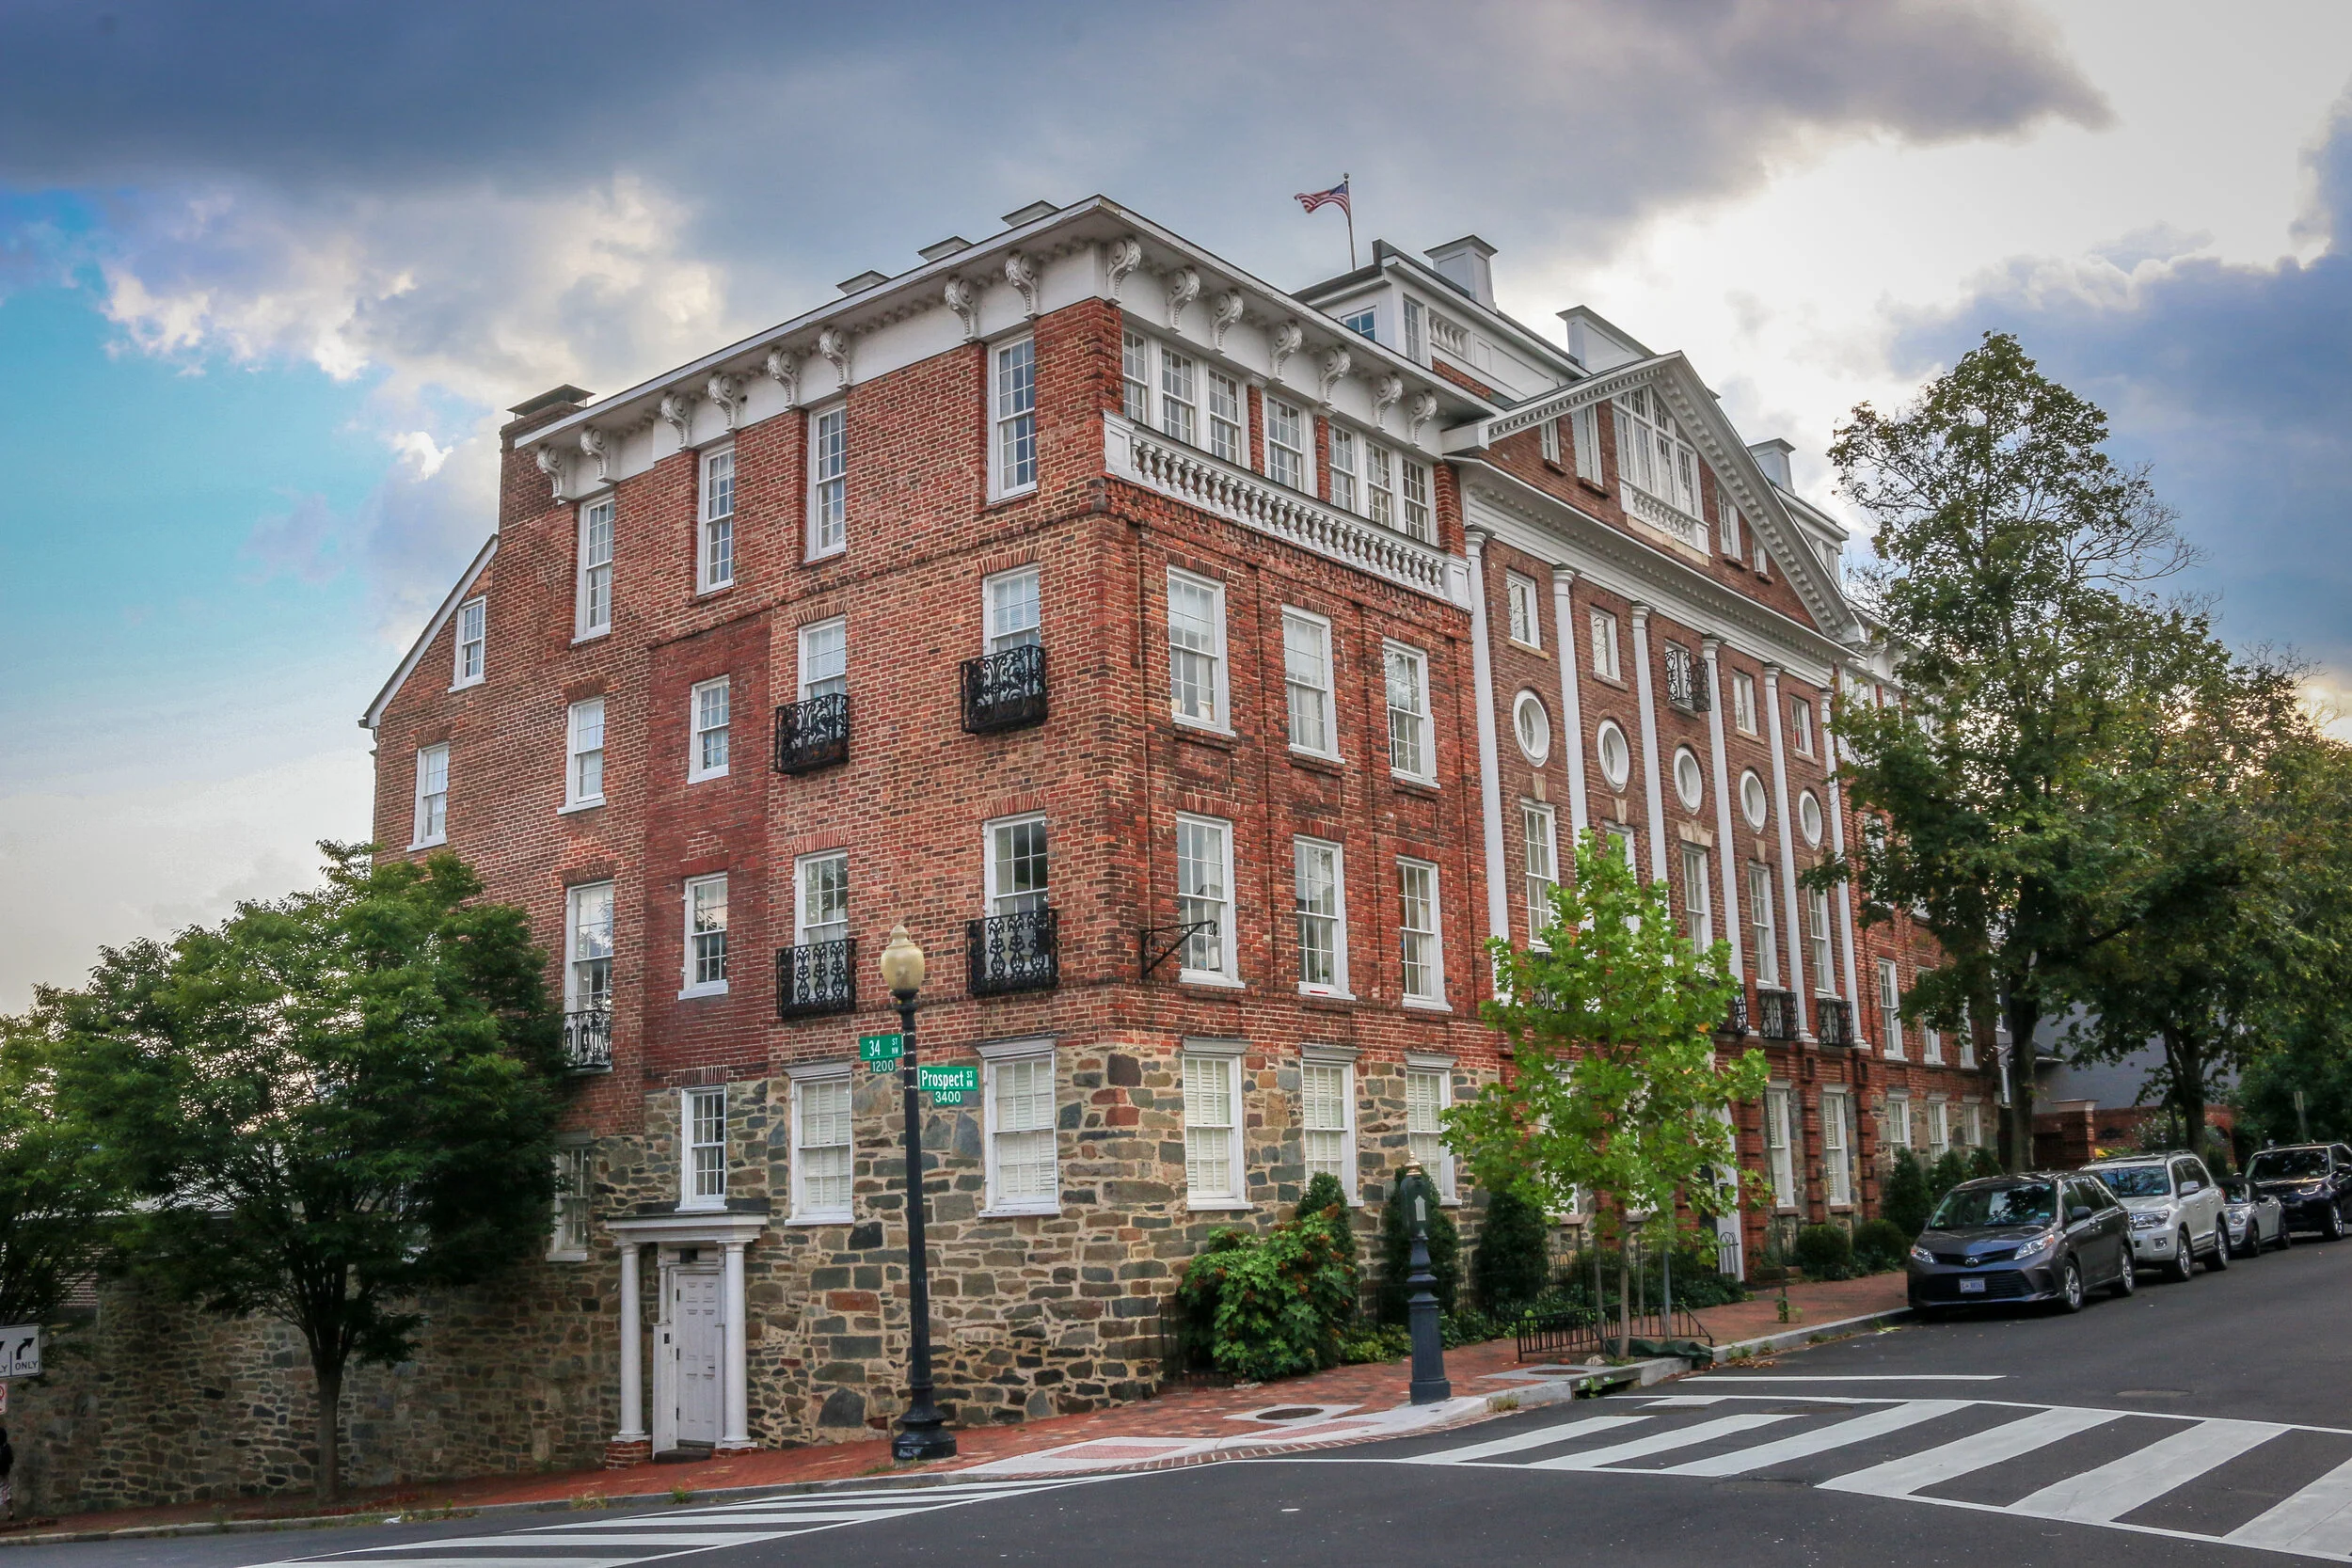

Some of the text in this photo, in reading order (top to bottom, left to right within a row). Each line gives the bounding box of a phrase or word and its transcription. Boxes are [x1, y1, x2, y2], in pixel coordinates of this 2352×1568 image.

[868, 1037, 898, 1057] 34 ST
[872, 1060, 895, 1072] 1200
[921, 1069, 974, 1091] Prospect ST
[935, 1091, 961, 1103] 3400
[15, 1361, 39, 1370] ONLY
